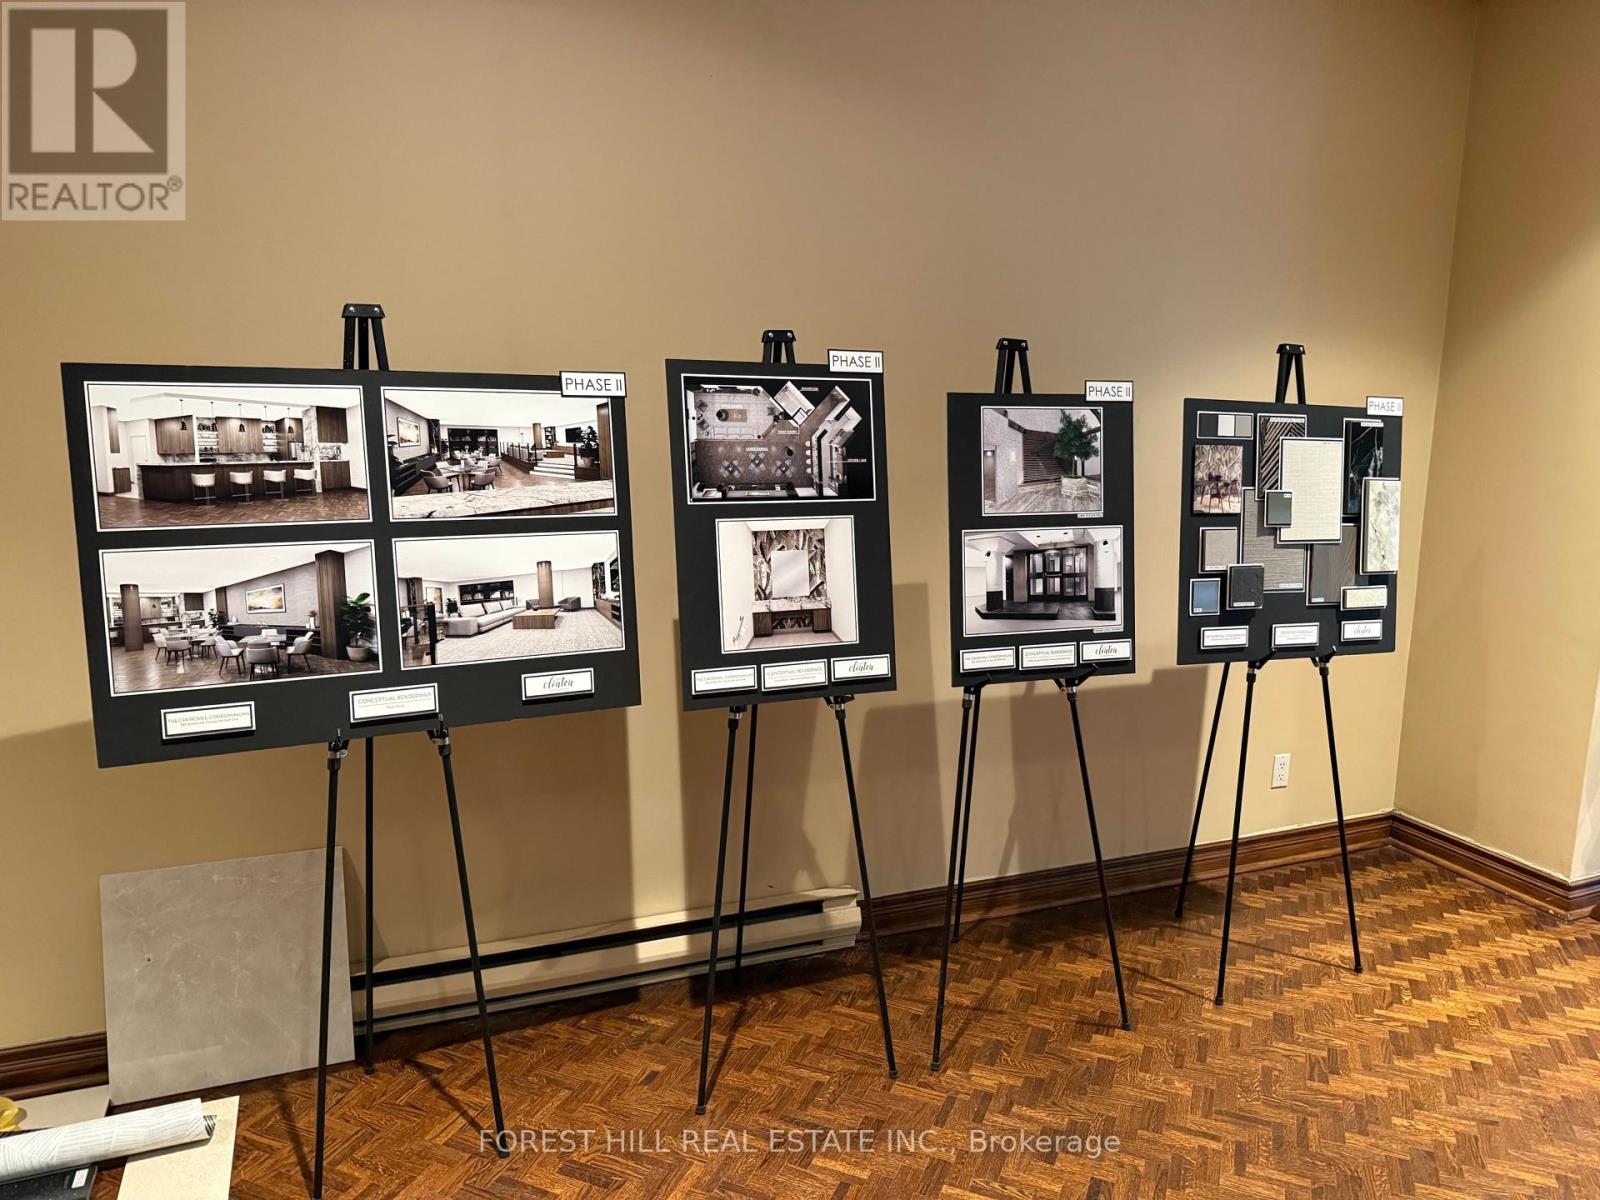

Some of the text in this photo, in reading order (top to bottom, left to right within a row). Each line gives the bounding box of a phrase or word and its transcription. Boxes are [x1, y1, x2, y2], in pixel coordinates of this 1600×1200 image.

[832, 355, 881, 368] PHASE II
[565, 378, 623, 391] PHASE II
[1089, 386, 1123, 397] PHASE
[1369, 400, 1395, 412] PHASE
[357, 696, 395, 705] CONCEPTUAL
